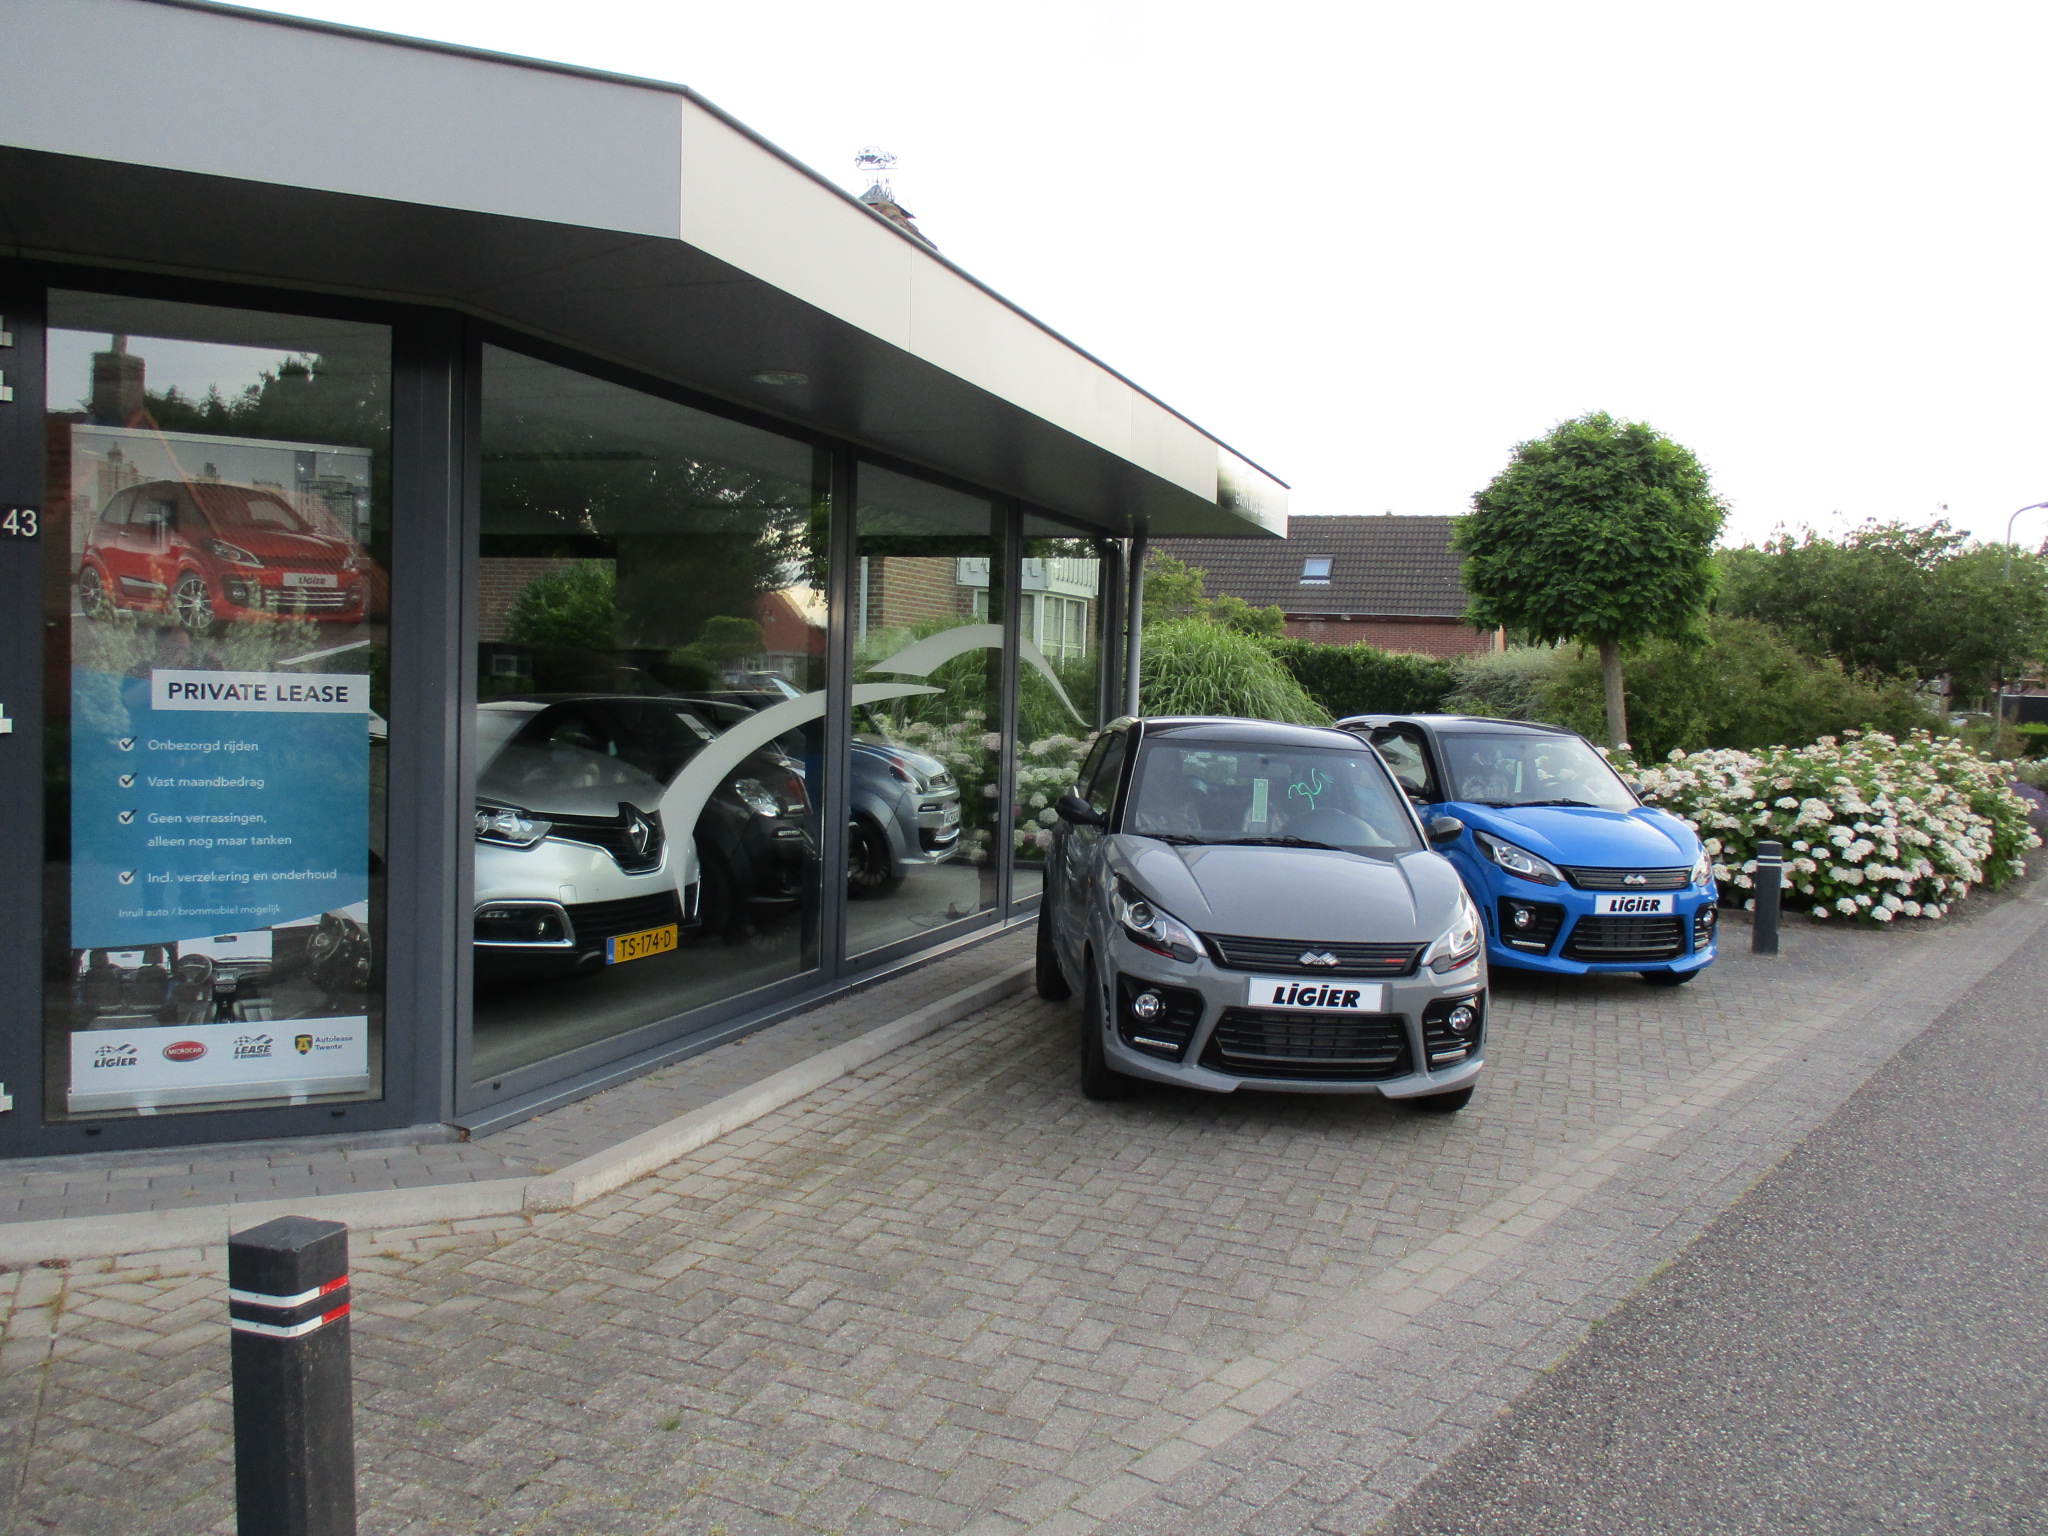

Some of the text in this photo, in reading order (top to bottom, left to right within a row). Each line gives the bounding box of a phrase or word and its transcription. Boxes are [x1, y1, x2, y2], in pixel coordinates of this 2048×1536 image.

[3, 508, 38, 537] 43
[168, 682, 349, 703] PRIVATE LEASE
[148, 739, 259, 754] Onbezorgd rijden
[147, 776, 265, 789] Vast maandbedrag
[147, 812, 267, 826] Geen verrassingen,
[147, 834, 292, 849] alleen nog maar tanken
[147, 868, 338, 884] Incl. verzekering en onderhoud
[118, 908, 144, 918] Inruil
[146, 909, 169, 917] auto
[178, 905, 239, 917] brommobiel
[240, 904, 281, 915] mogelijk
[621, 930, 671, 958] TS-174-D
[315, 1035, 353, 1044] Autolease
[168, 1047, 202, 1056] MICROCAR
[234, 1044, 272, 1055] LEASE
[315, 1043, 342, 1051] Twente
